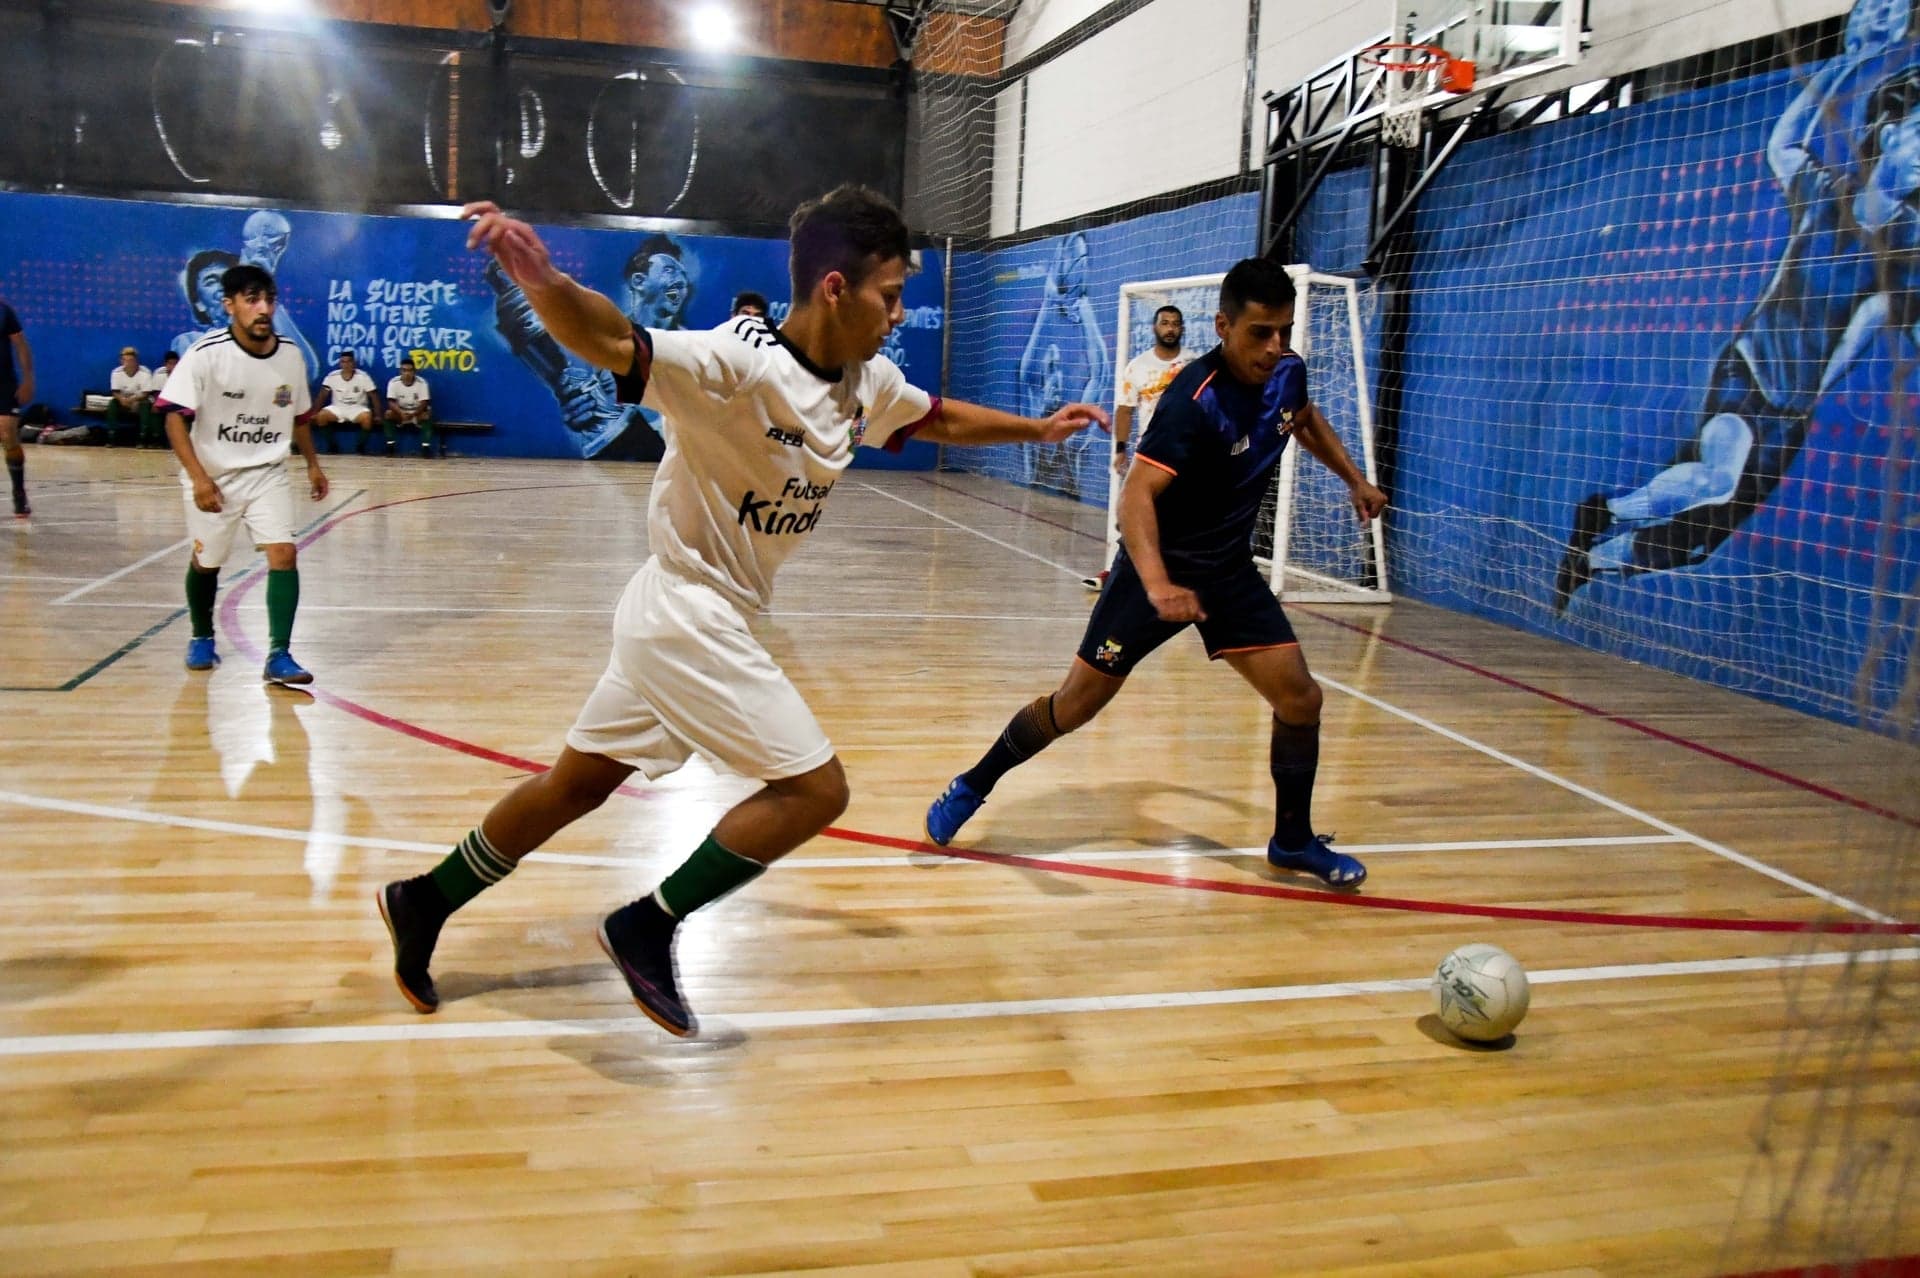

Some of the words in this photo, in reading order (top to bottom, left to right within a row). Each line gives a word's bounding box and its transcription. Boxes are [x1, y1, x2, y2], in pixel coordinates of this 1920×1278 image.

[328, 279, 352, 301] LA
[366, 278, 458, 305] SUERTE
[327, 303, 358, 322] NO
[364, 303, 433, 325] TIENE
[327, 322, 377, 345] NADA
[383, 325, 427, 349] QUE
[429, 327, 474, 350] VER
[381, 346, 402, 369] EL
[236, 413, 270, 424] Futsal
[217, 423, 282, 443] Kinder
[781, 478, 835, 500] Futsal
[738, 490, 822, 535] Kind
